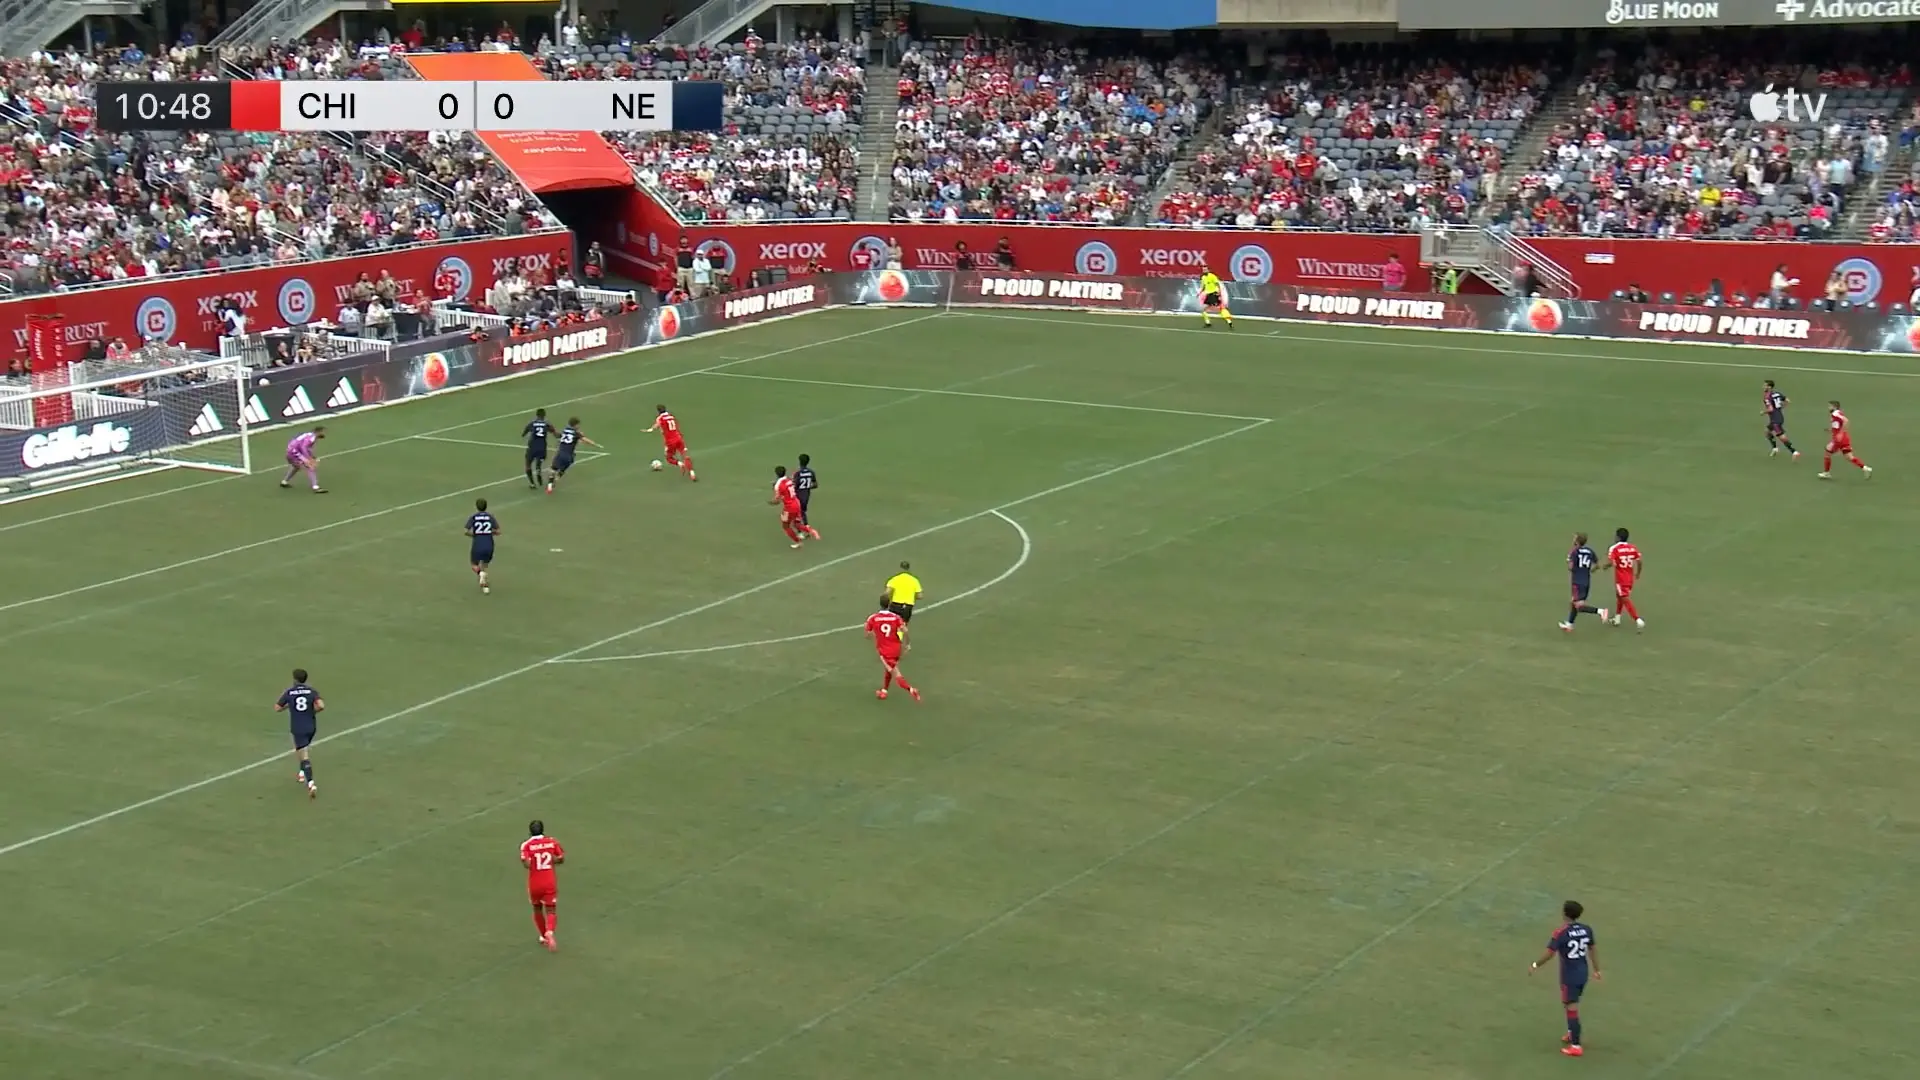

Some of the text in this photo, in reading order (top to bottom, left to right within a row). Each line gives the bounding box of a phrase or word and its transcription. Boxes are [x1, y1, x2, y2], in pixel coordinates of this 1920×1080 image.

[1606, 0, 1718, 24] BLUE MOON
[760, 242, 827, 260] xerox
[1141, 249, 1206, 266] xerox
[981, 278, 1123, 301] PROUD PARTNER
[725, 285, 815, 319] PROUD PARTNER
[1296, 293, 1445, 319] PROUD PARTNER
[1639, 311, 1810, 339] PROUD PARTNER
[503, 327, 607, 367] PROUD PARTNER
[535, 427, 545, 437] 2
[560, 434, 574, 444] 23
[22, 421, 130, 468] Gillette
[799, 478, 812, 489] 21
[474, 521, 492, 534] 22
[1578, 554, 1591, 568] 14
[1619, 555, 1635, 568] 35
[880, 623, 891, 637] 9
[296, 696, 308, 711] 8
[534, 851, 552, 870] 12
[1567, 938, 1590, 958] 25
